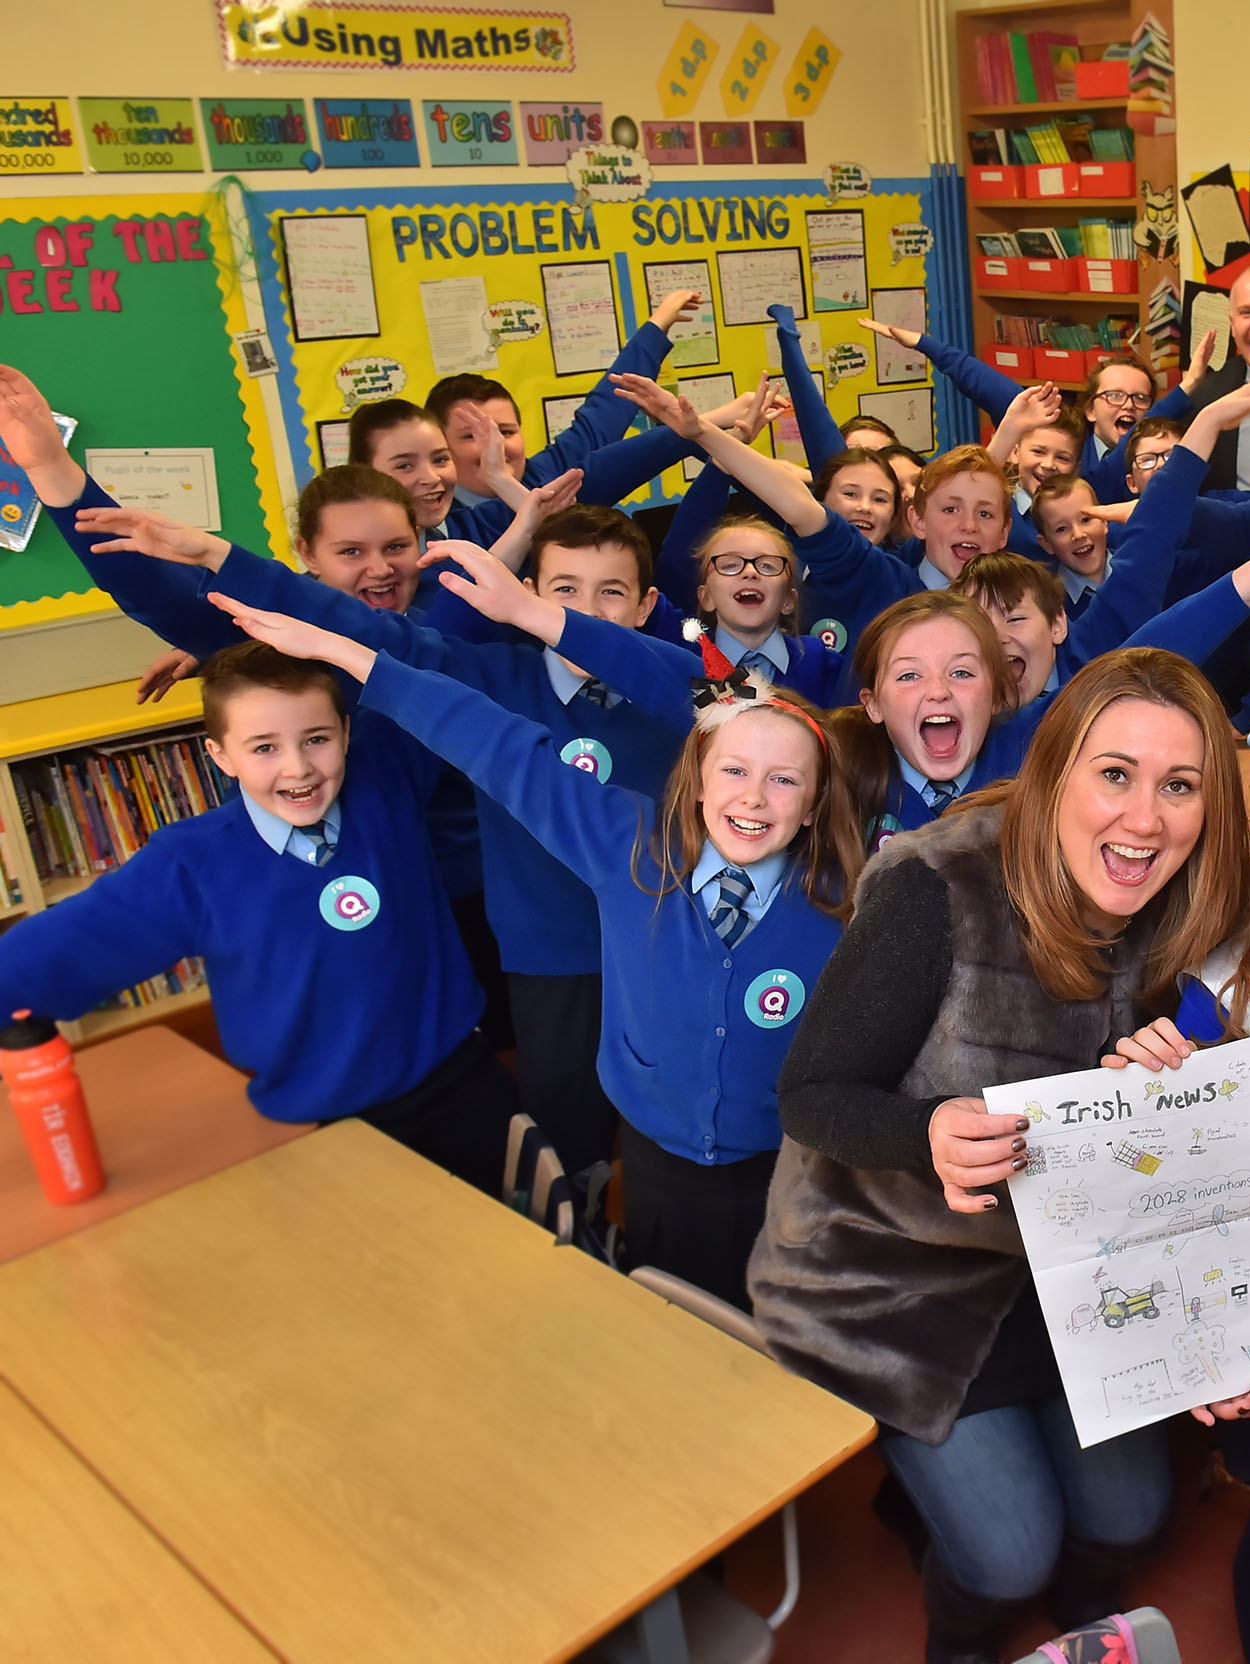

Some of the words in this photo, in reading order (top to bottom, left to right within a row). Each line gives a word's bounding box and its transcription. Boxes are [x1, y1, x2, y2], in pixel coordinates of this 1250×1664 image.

[281, 15, 402, 67] Using
[414, 26, 531, 60] Maths
[731, 80, 749, 102] 2
[793, 82, 811, 102] 3
[122, 102, 159, 124] ten
[210, 102, 307, 145] thousands
[321, 101, 412, 143] hundreds
[430, 104, 513, 144] tens
[527, 105, 603, 143] units
[92, 121, 195, 146] thousands
[123, 152, 174, 167] 10,000
[469, 148, 483, 161] 10
[611, 169, 642, 186] About
[35, 222, 95, 269] OF
[113, 217, 209, 264] THE
[393, 206, 601, 264] PROBLEM
[632, 199, 791, 247] SOLVING
[0, 269, 123, 316] EEK
[340, 895, 365, 916] Q
[764, 991, 785, 1013] Q
[763, 1012, 785, 1021] Radio
[1056, 1090, 1132, 1126] Irish
[1140, 1189, 1188, 1214] 2028
